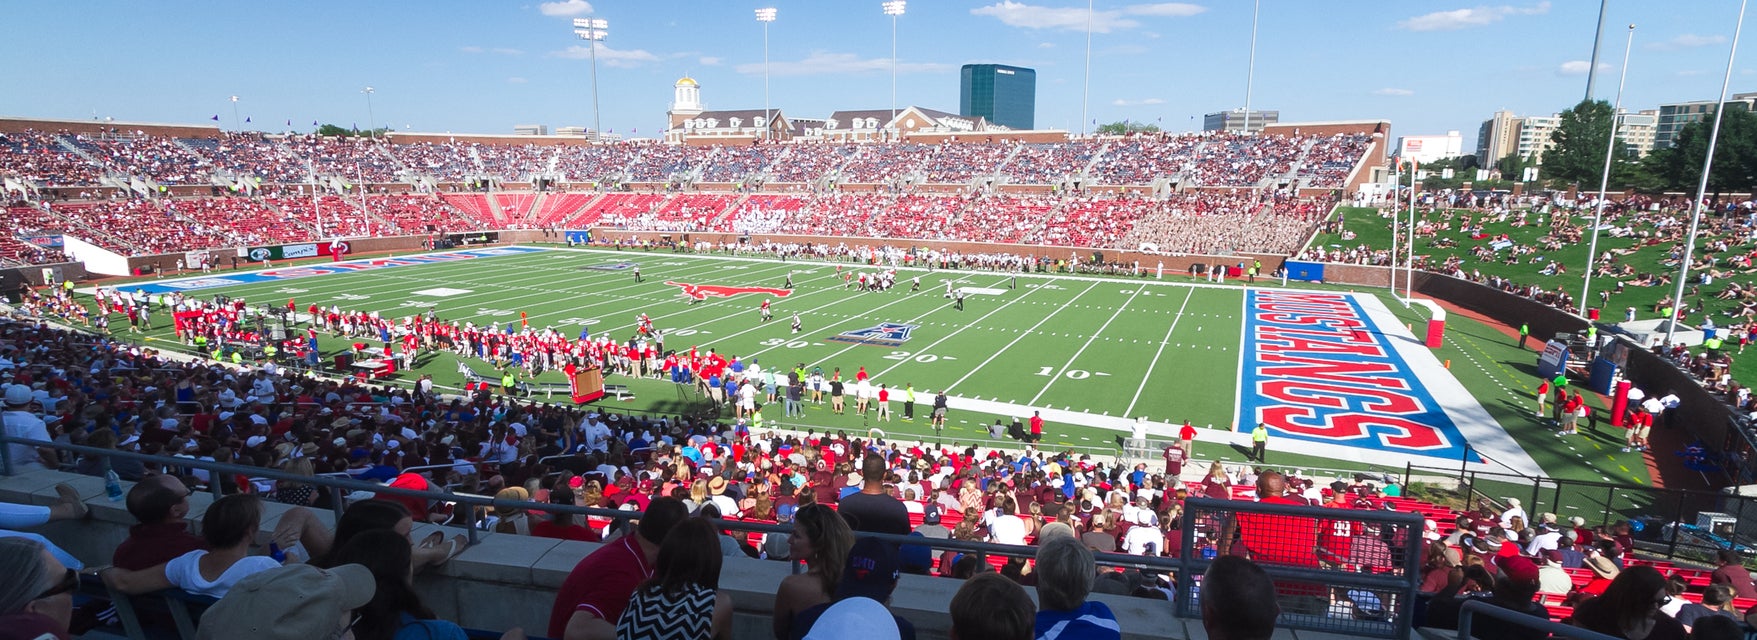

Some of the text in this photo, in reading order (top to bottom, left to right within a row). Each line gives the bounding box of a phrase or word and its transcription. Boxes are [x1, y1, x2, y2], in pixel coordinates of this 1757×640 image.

[257, 253, 478, 278] SMU
[759, 338, 808, 349] 30
[882, 351, 938, 363] 20
[1034, 366, 1091, 380] 10
[1255, 290, 1452, 450] MUSTANGS
[852, 552, 876, 571] SMU
